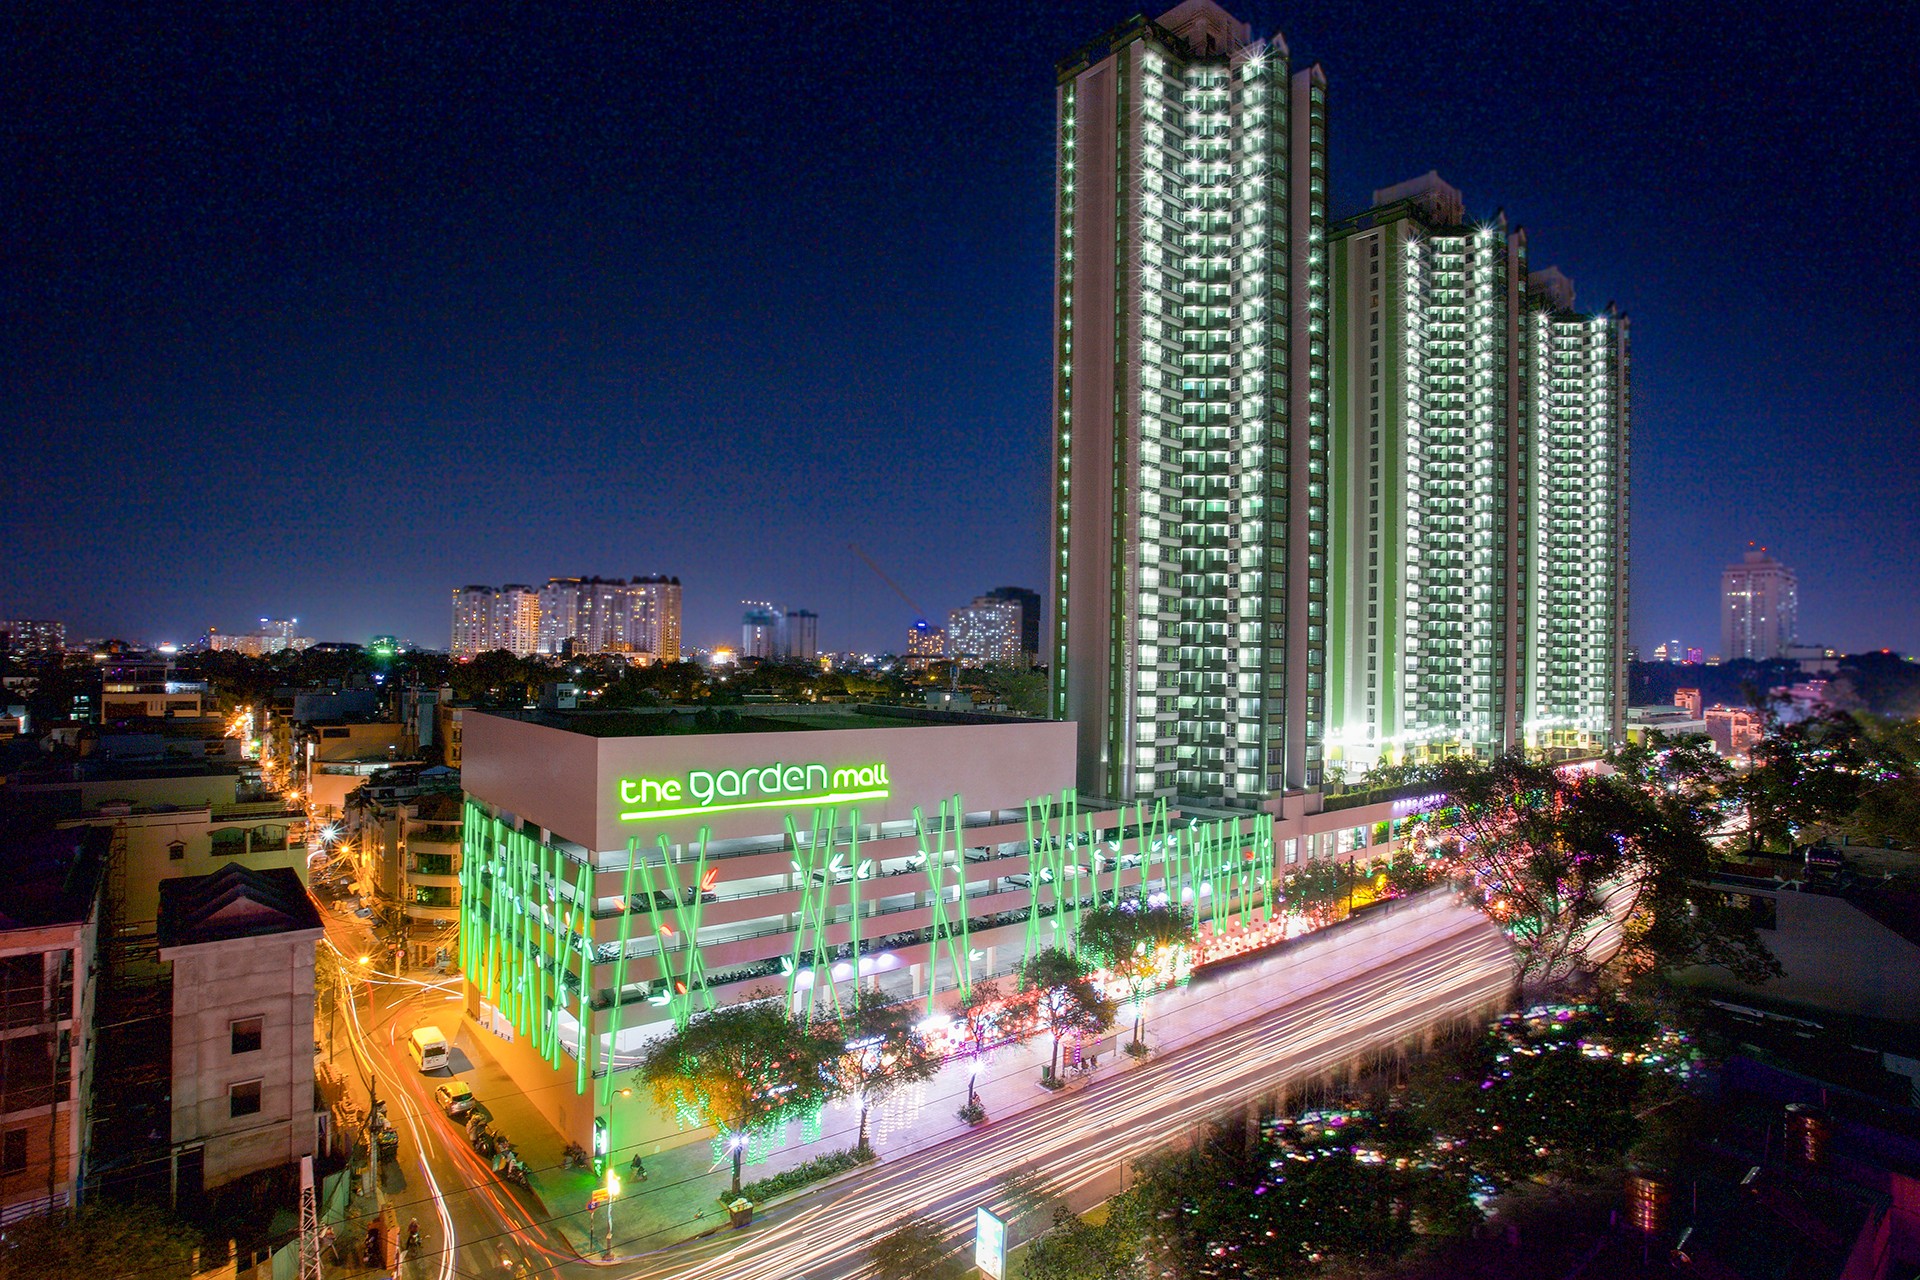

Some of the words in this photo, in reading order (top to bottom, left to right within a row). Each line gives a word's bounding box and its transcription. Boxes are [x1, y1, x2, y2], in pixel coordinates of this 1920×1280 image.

[621, 779, 681, 803] the
[690, 763, 827, 806] garden
[833, 764, 889, 788] mall
